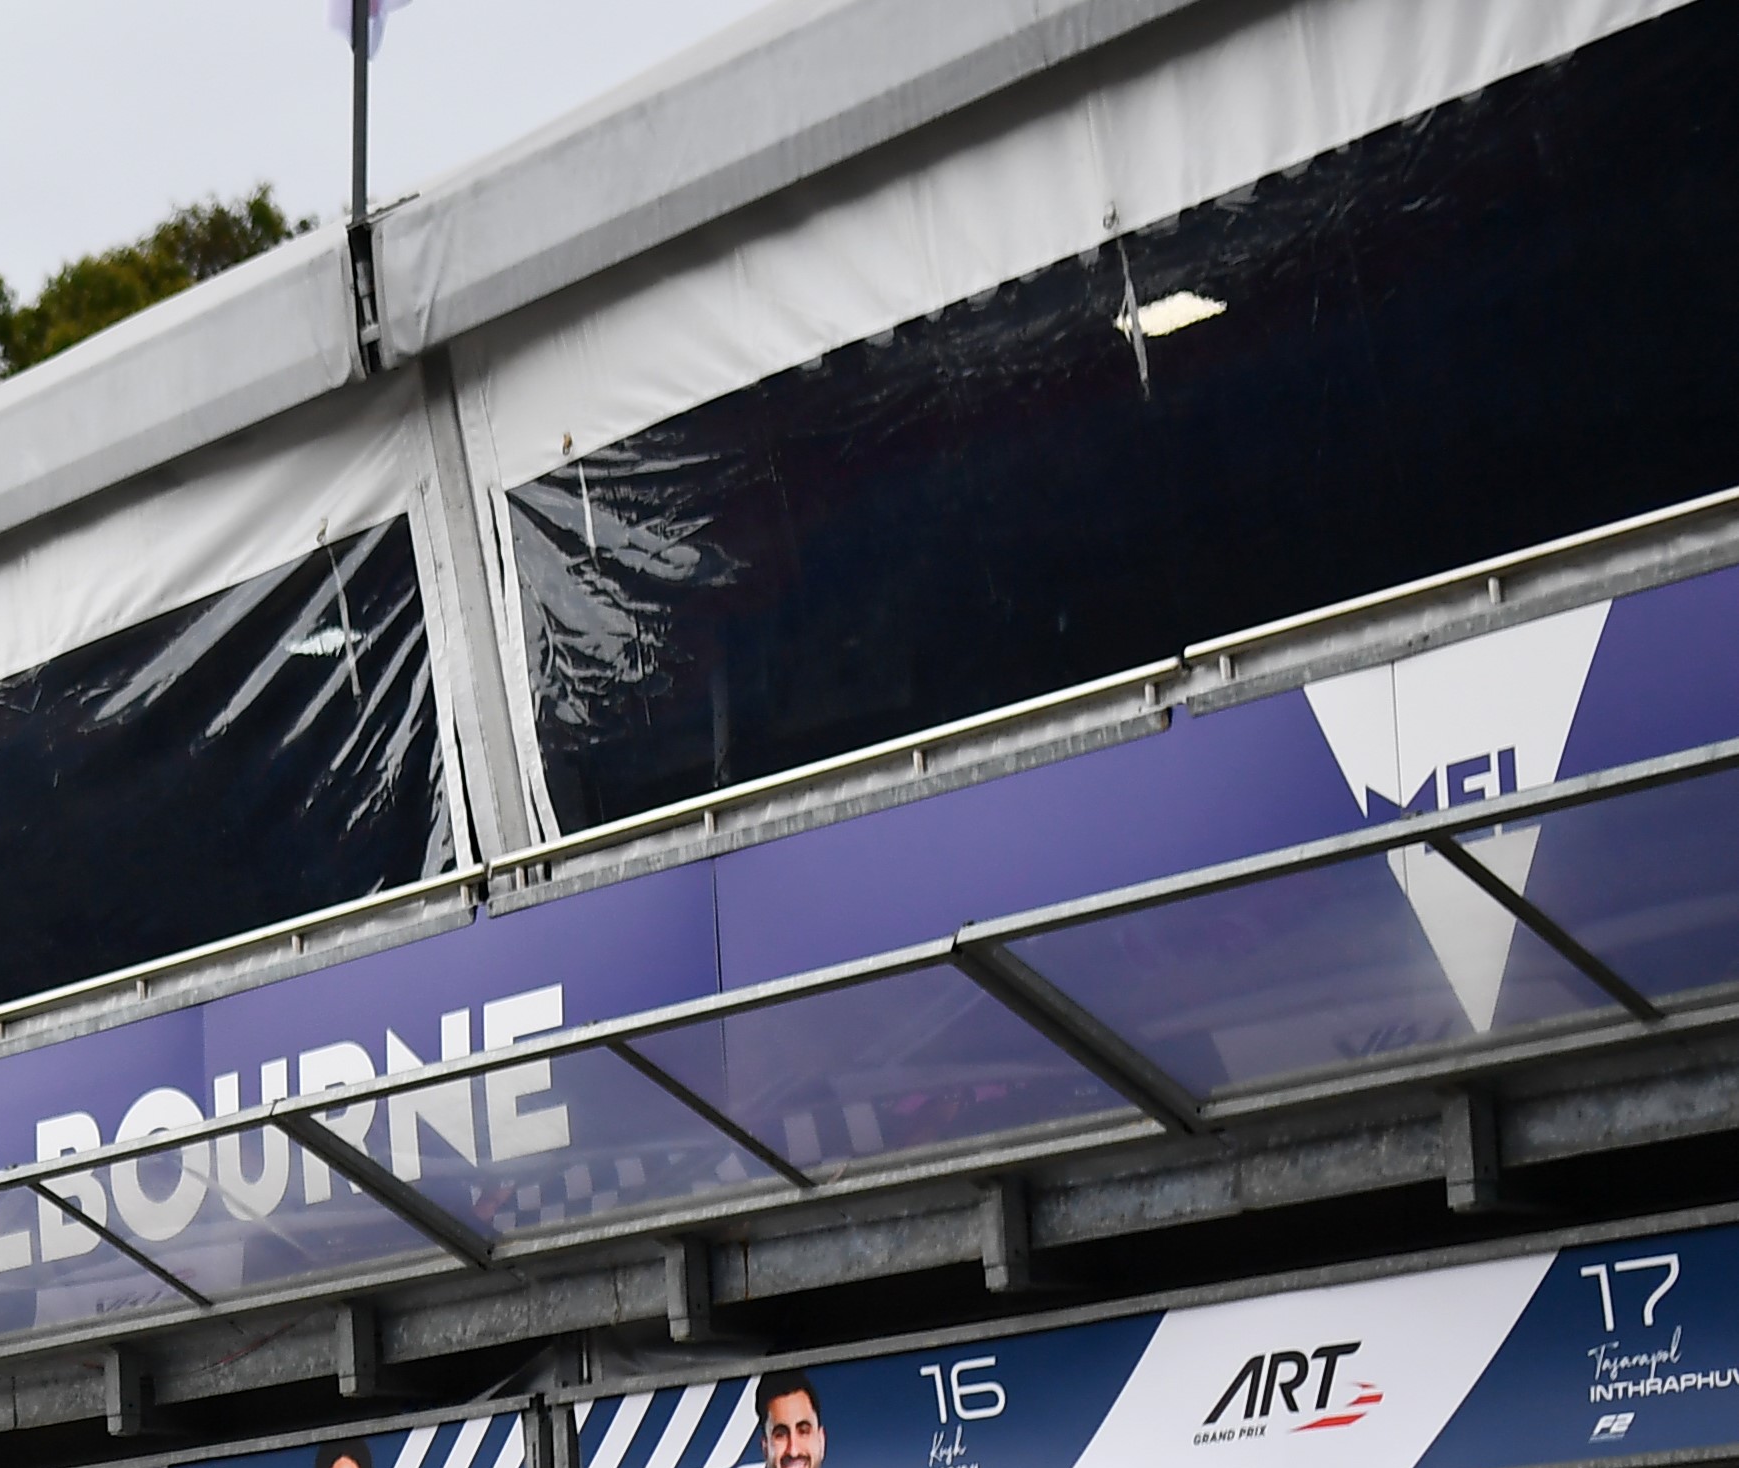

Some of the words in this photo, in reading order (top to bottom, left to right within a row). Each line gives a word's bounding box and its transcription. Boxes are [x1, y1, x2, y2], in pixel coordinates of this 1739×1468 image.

[1581, 1253, 1679, 1332] 17
[920, 1356, 1006, 1423] 16
[1203, 1340, 1362, 1426] ART
[1193, 1428, 1235, 1446] GRAND
[1239, 1425, 1266, 1441] PRIX
